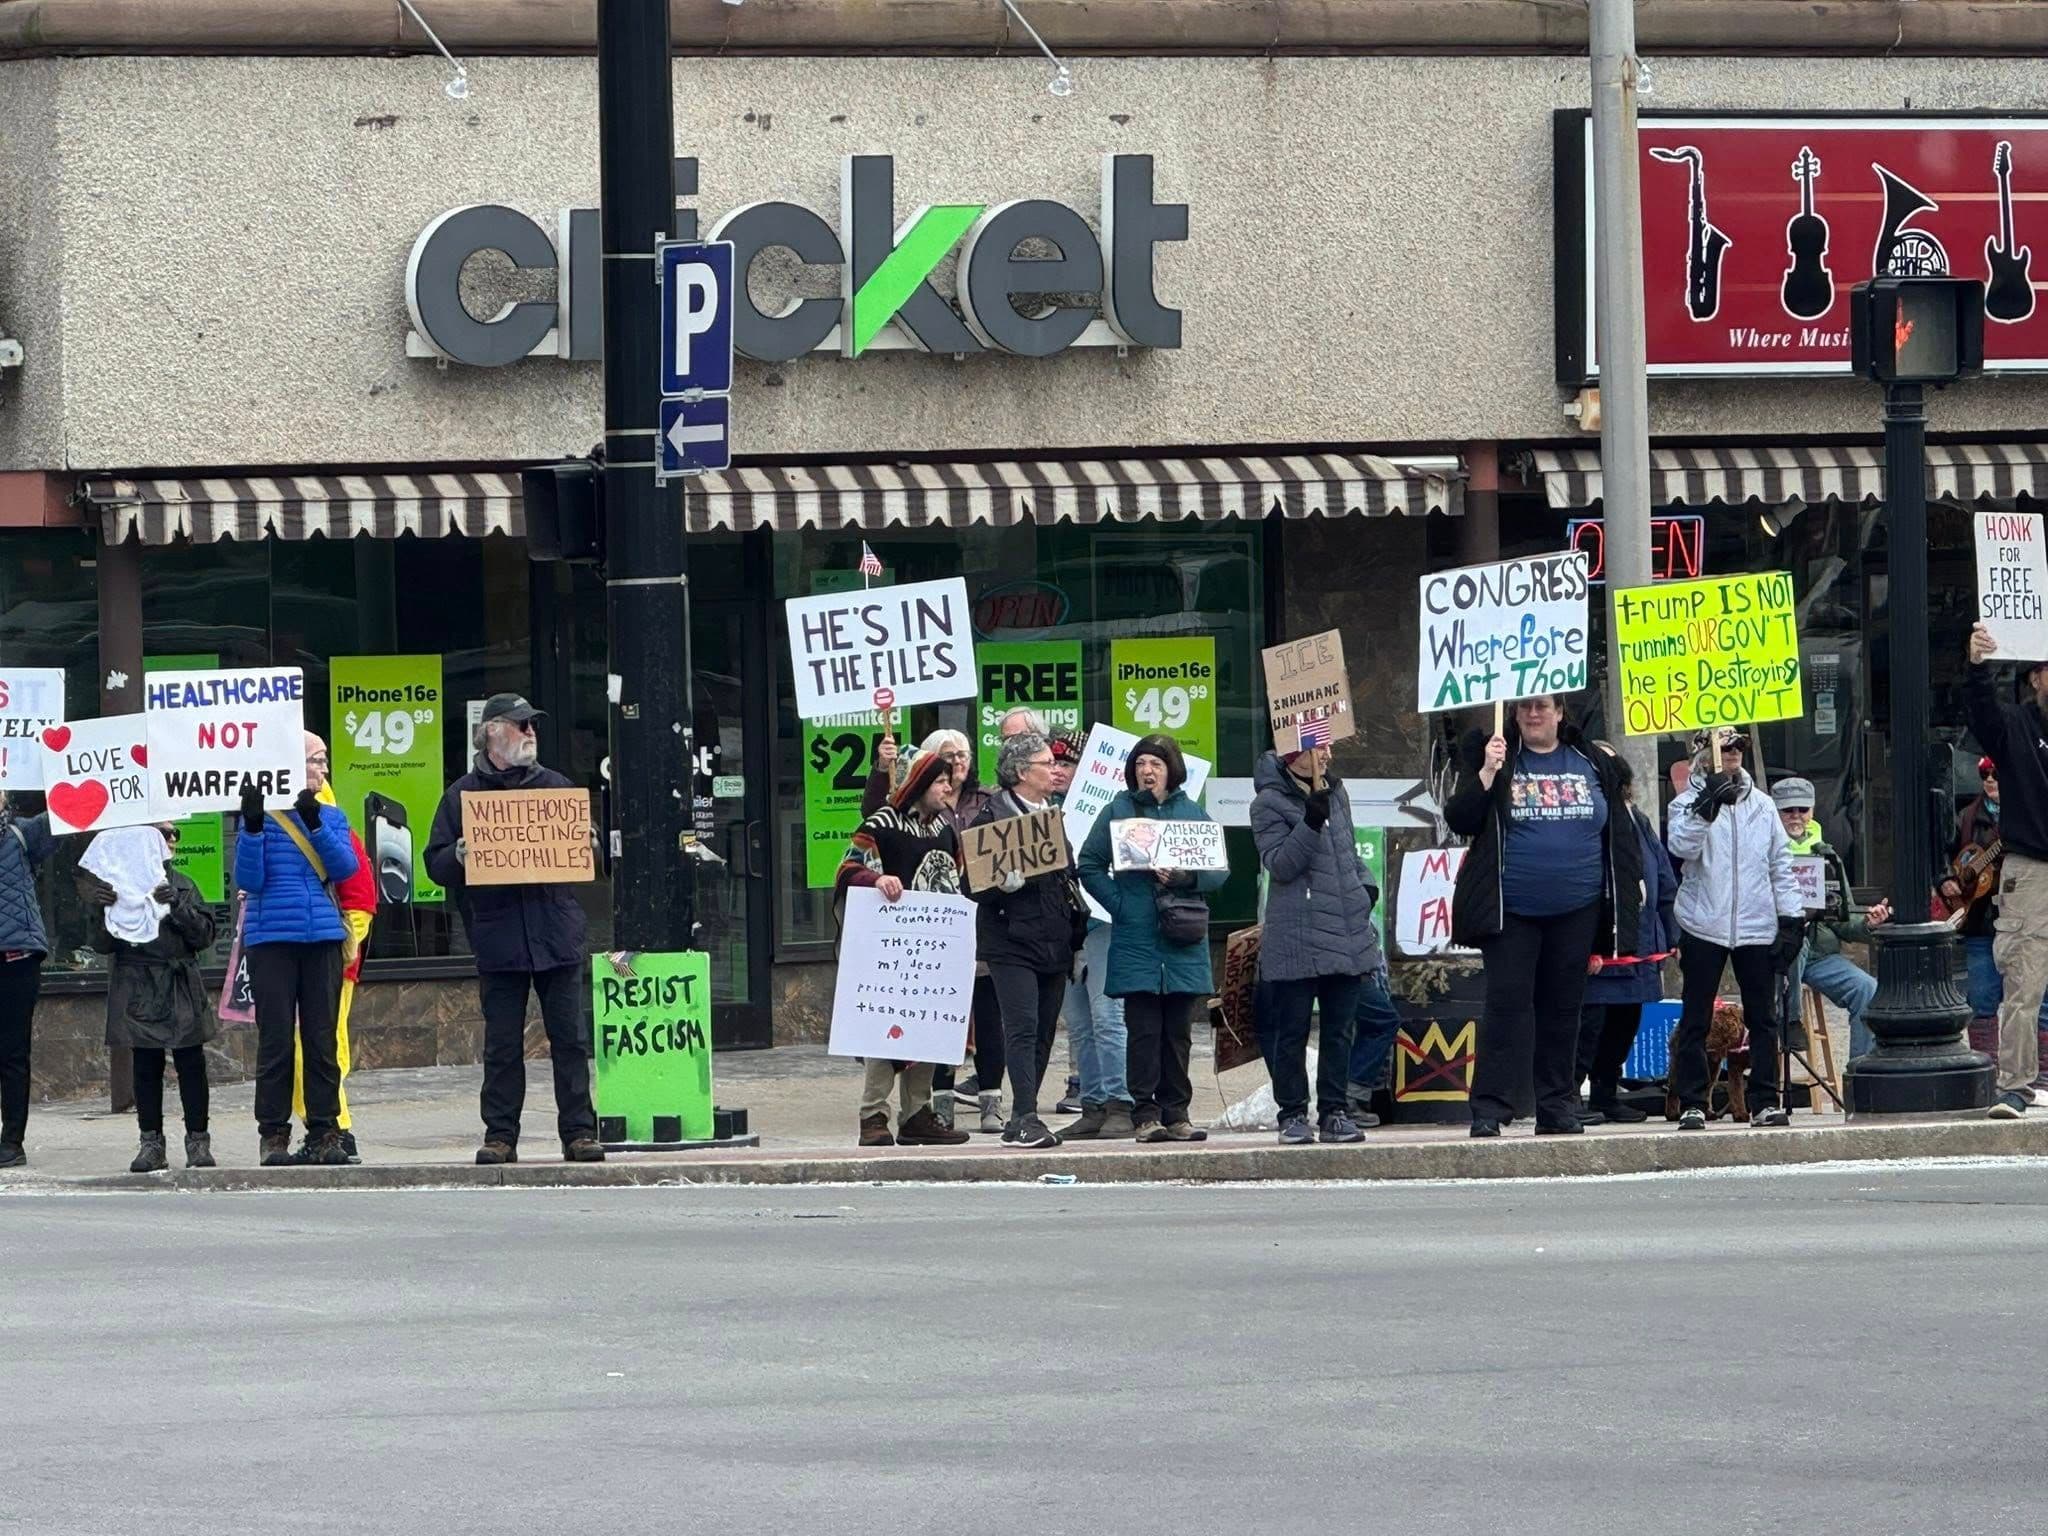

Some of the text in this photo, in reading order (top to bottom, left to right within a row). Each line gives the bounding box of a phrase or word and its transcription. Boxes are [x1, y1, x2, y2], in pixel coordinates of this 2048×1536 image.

[675, 262, 719, 376] P
[1729, 326, 1852, 348] Where Musi
[1985, 515, 2033, 542] HONK
[1574, 520, 1699, 578] OEN
[1999, 547, 2021, 562] FOR
[1425, 554, 1588, 615] CONGRESS
[1718, 582, 1751, 614] IS
[1757, 573, 1793, 610] NOT
[1989, 567, 2033, 594] FREE
[1982, 594, 2042, 620] SPEECH
[801, 593, 953, 654] HE'S IN
[1428, 613, 1584, 671] Wherefore
[1619, 632, 1687, 663] running
[808, 641, 958, 697] THE FILES
[1118, 662, 1211, 681] iPhone 16e
[1274, 635, 1335, 681] ICE
[1628, 669, 1657, 695] he
[1667, 666, 1689, 693] is
[1697, 652, 1799, 692] Destroying
[148, 674, 304, 710] HEALTHCARE
[337, 684, 437, 703] iPhone 16e
[981, 662, 1078, 703] FREE
[1433, 658, 1585, 708] Art Thou
[198, 722, 259, 749] NOT
[66, 747, 124, 776] LOVE
[109, 774, 145, 803] FOR
[164, 768, 292, 798] WARFARE
[468, 798, 589, 825] WHITEHOUSE
[472, 822, 587, 844] PROTECTING
[977, 809, 1056, 857] LYIN'
[1162, 836, 1218, 848] HEAD OF
[474, 847, 591, 871] PEDOPHILES
[991, 840, 1058, 886] KING
[1179, 856, 1216, 867] HATE
[602, 974, 697, 1017] RESIST
[602, 1018, 706, 1059] FASCISM
